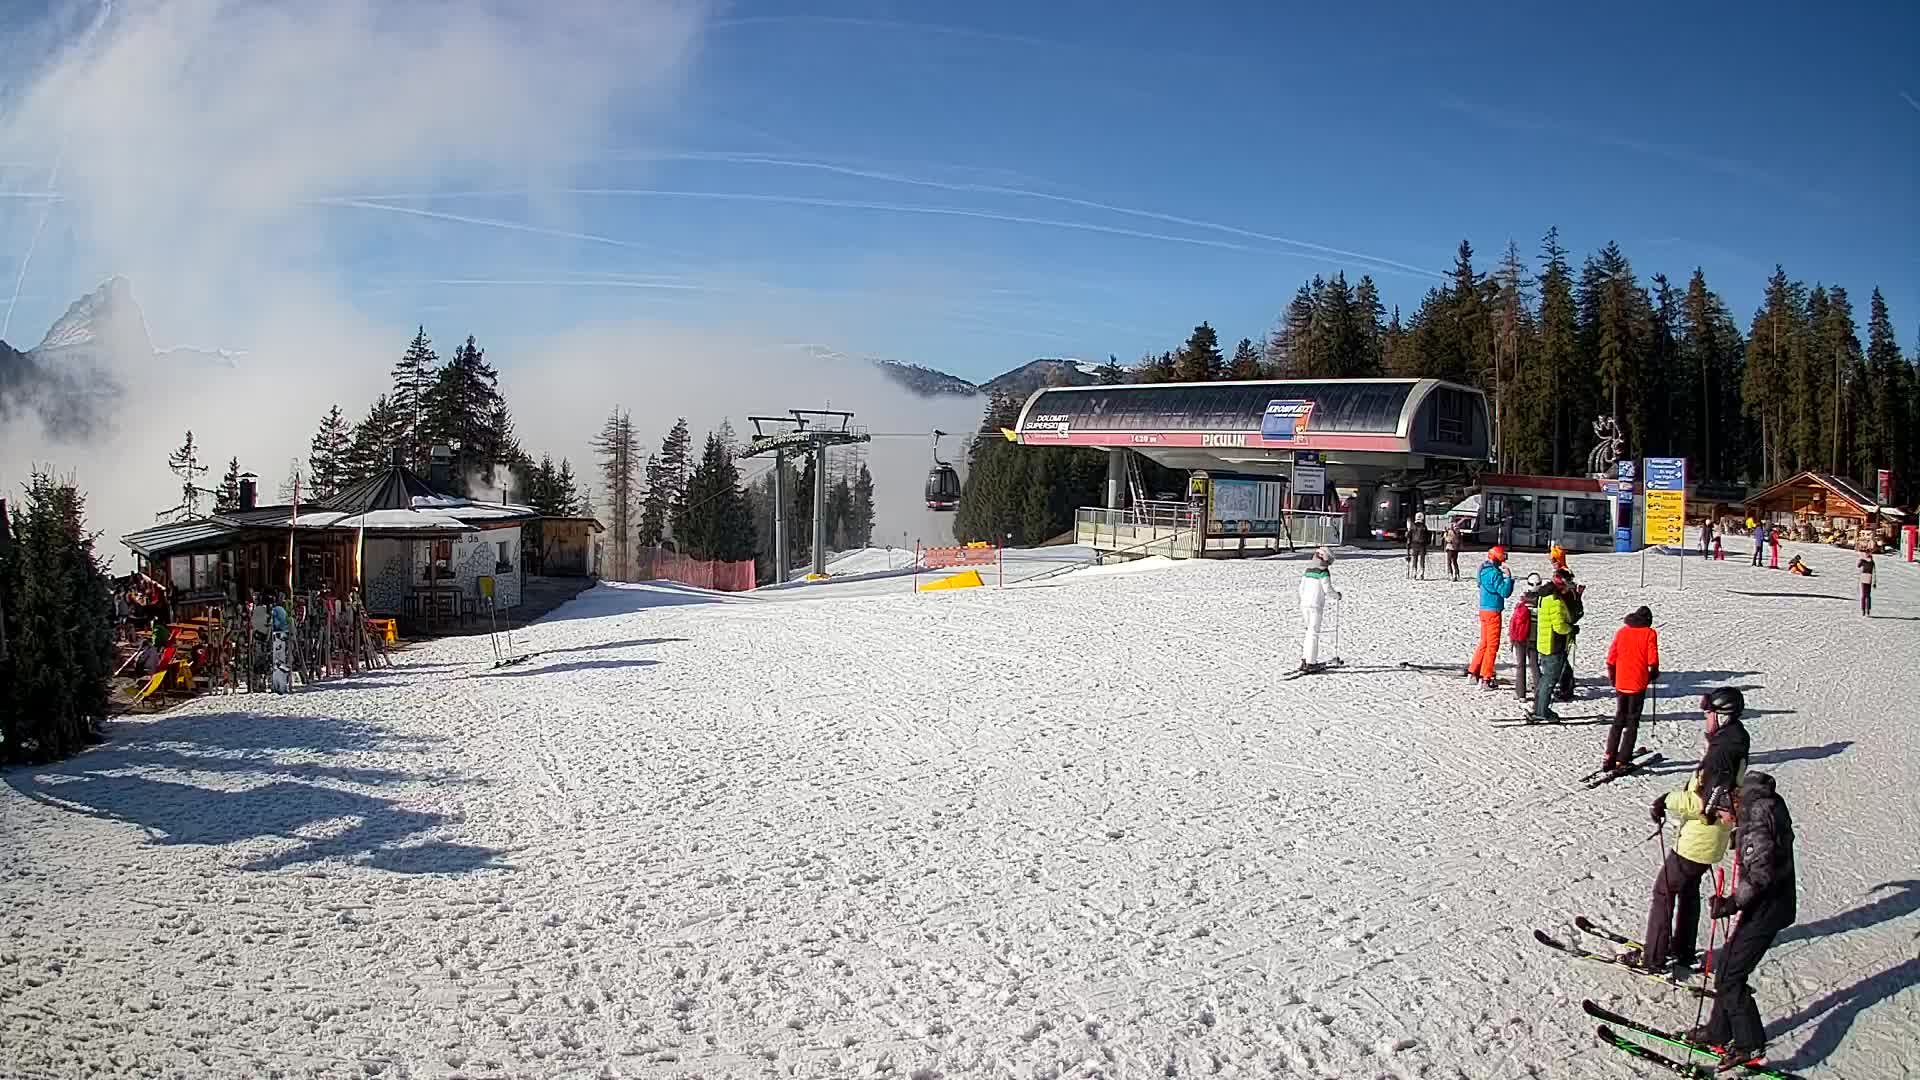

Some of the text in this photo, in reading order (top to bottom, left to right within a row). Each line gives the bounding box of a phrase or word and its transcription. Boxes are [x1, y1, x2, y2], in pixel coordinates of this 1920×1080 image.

[1036, 414, 1069, 422] DOLOMITI
[1025, 422, 1058, 430] SUPERSKI
[1201, 434, 1245, 447] PICULIN
